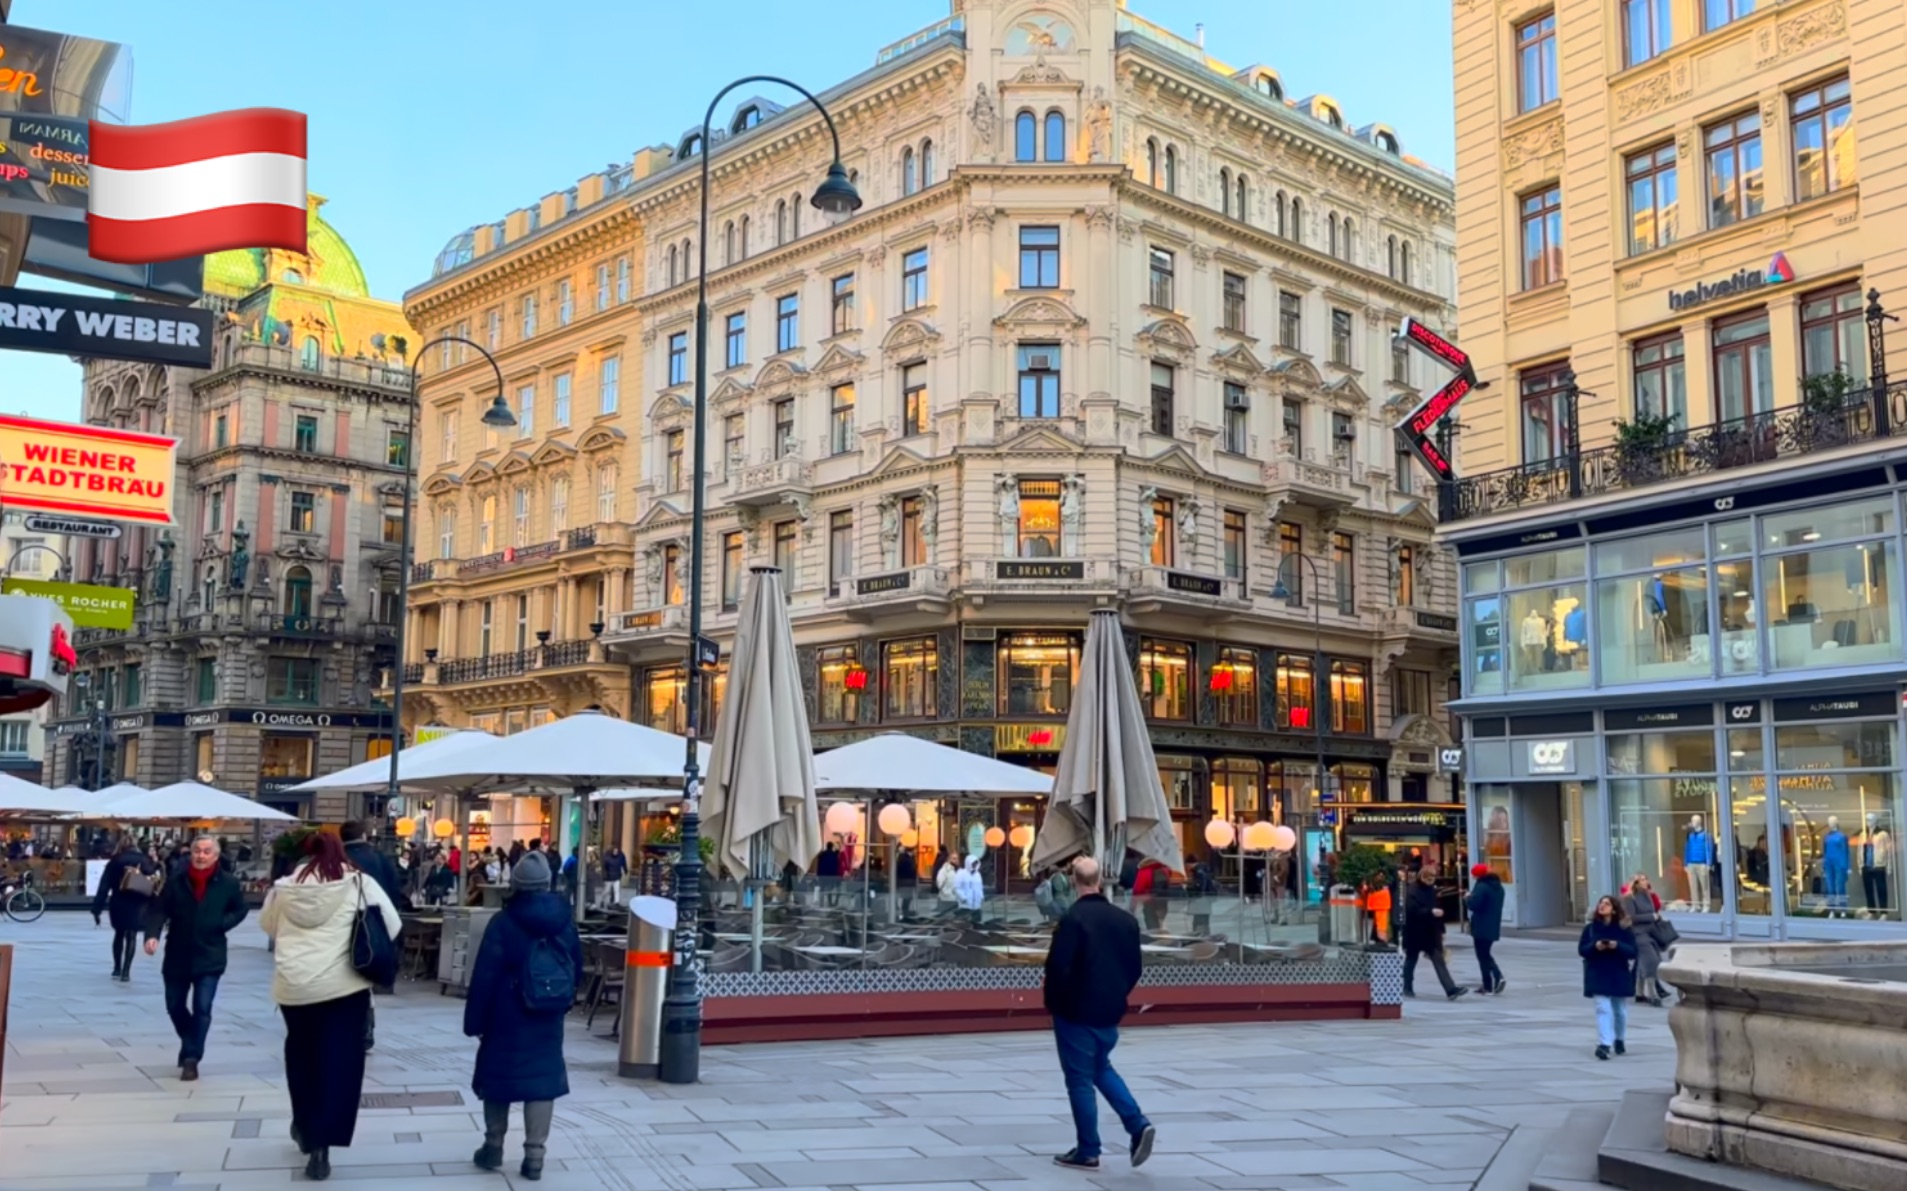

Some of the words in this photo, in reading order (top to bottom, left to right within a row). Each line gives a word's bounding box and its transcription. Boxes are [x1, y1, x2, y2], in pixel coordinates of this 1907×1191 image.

[48, 168, 89, 188] juic
[1669, 268, 1762, 310] helvetia
[74, 310, 201, 347] WEBER
[1412, 379, 1470, 436] FLEDERMAUS
[24, 443, 137, 473] WIENER
[33, 520, 115, 536] RESTAURANT
[1018, 566, 1051, 576] BRAUN
[71, 596, 127, 609] ROCHER
[269, 714, 314, 725] OMEGA
